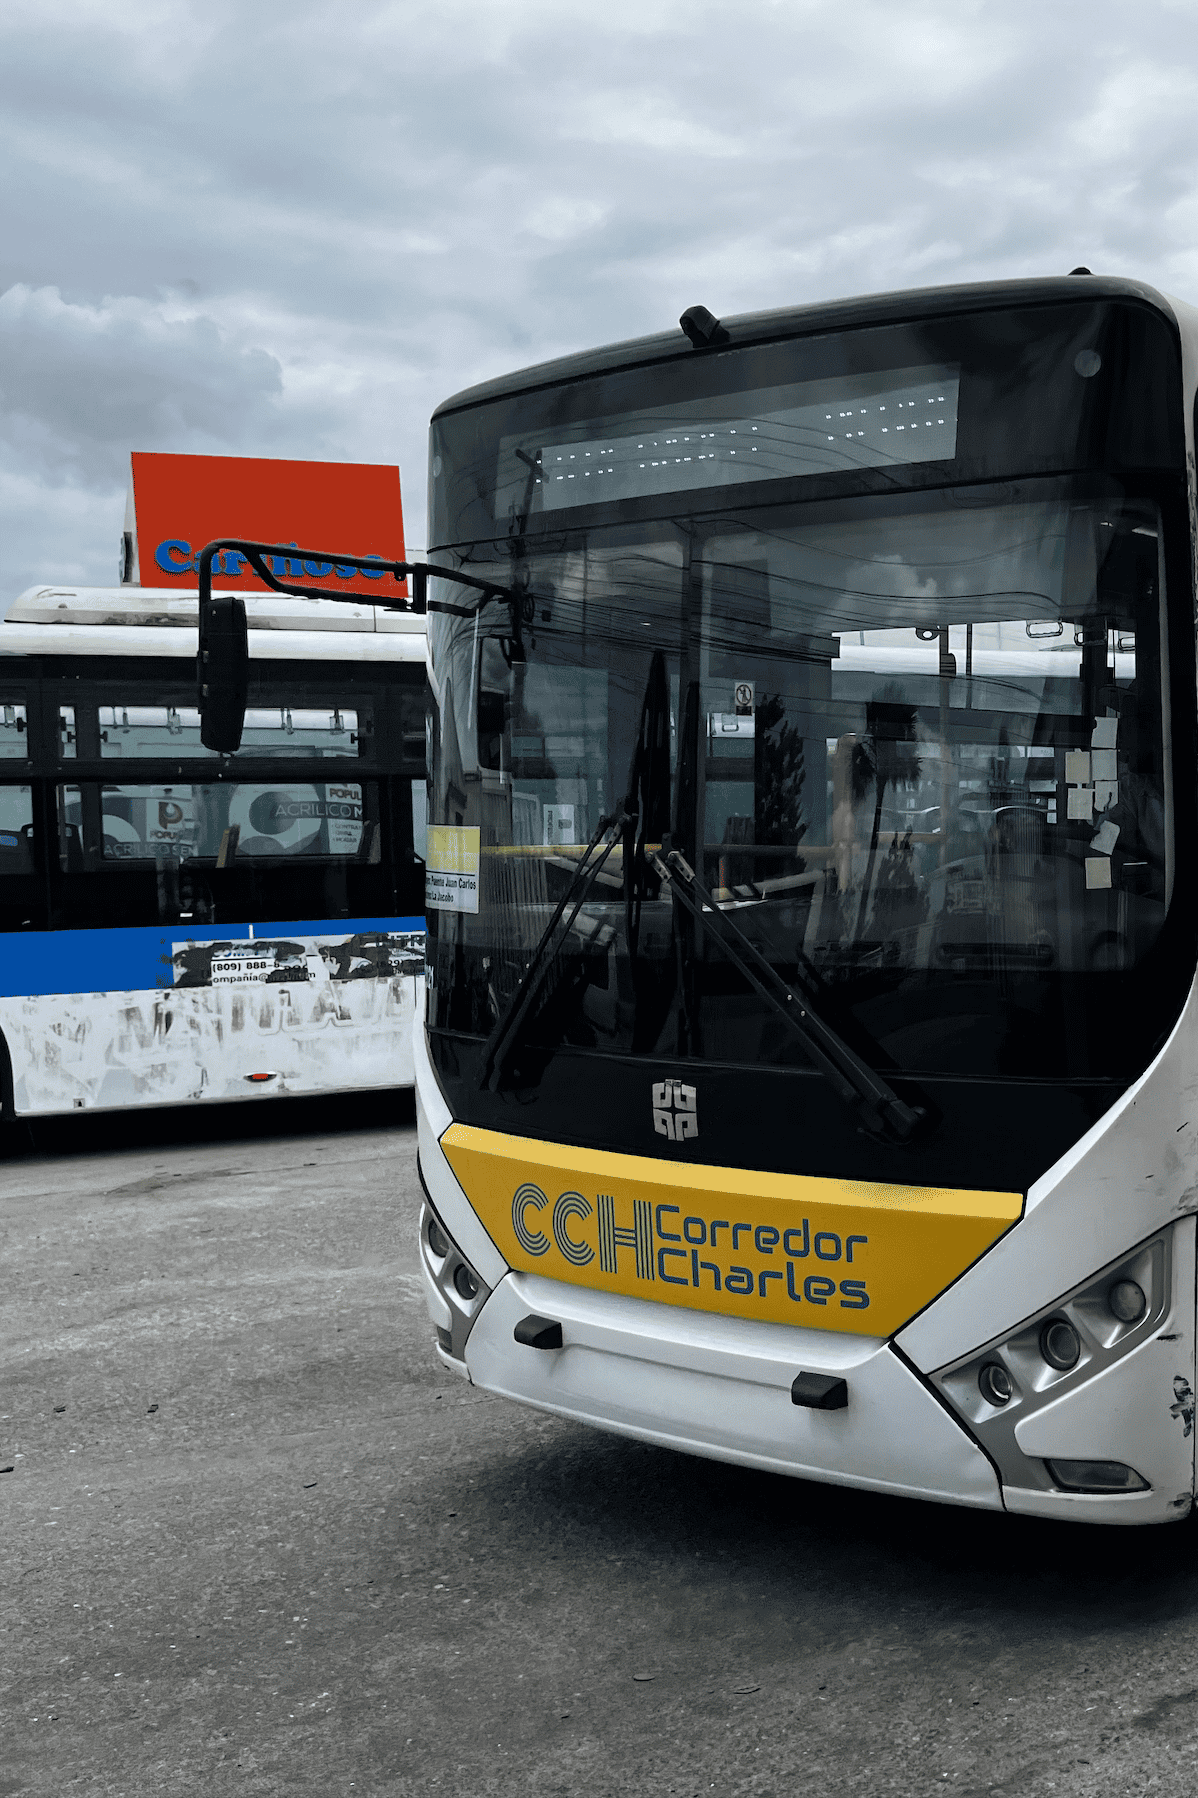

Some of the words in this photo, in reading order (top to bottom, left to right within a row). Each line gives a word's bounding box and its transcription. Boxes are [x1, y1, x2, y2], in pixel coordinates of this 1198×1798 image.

[275, 803, 351, 818] ACRILICO
[459, 877, 477, 890] Carlos
[212, 962, 241, 972] (809)
[511, 1182, 655, 1281] CCH
[655, 1204, 868, 1263] Corredor
[657, 1247, 870, 1310] Charles
